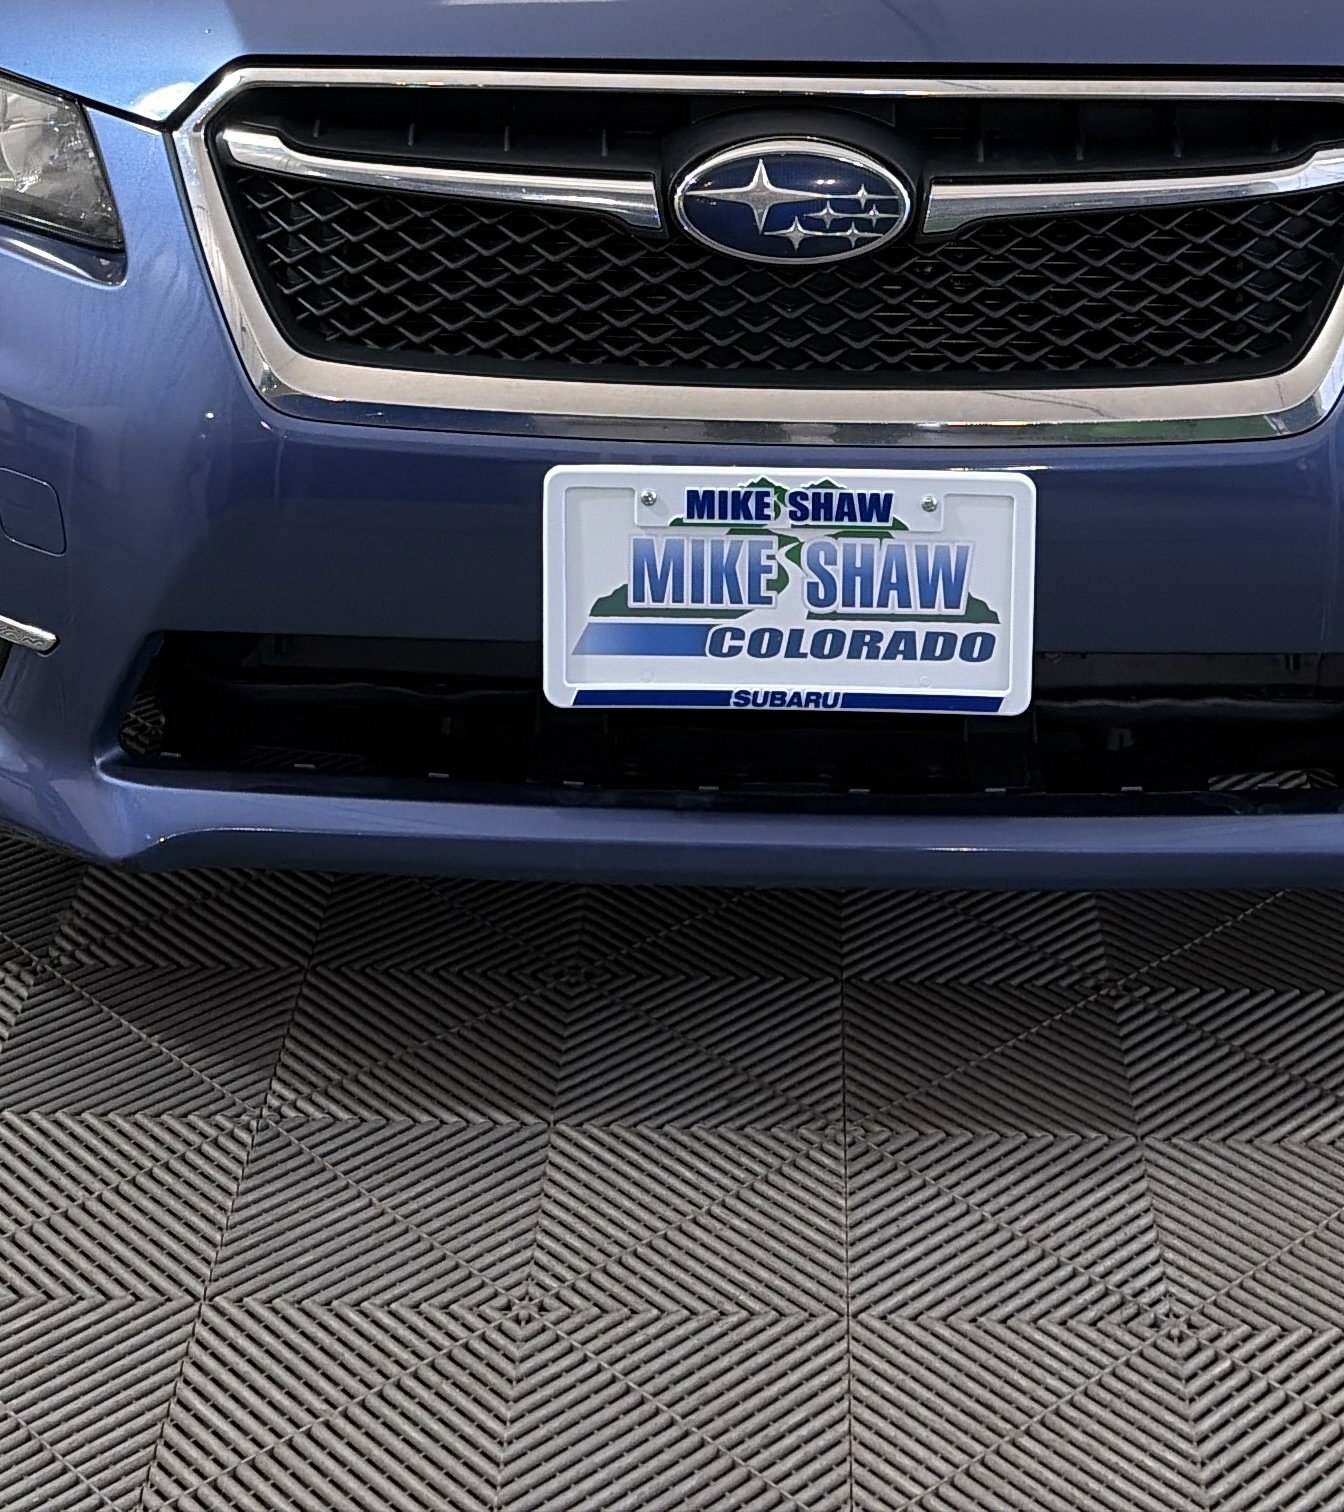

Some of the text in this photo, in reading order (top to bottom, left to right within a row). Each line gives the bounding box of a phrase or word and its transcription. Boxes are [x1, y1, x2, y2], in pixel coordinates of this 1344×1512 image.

[685, 488, 894, 524] MIKE SHAW
[631, 536, 971, 612] MIKE SHAW
[706, 626, 997, 663] COLORADO
[731, 690, 842, 710] SUBARU
